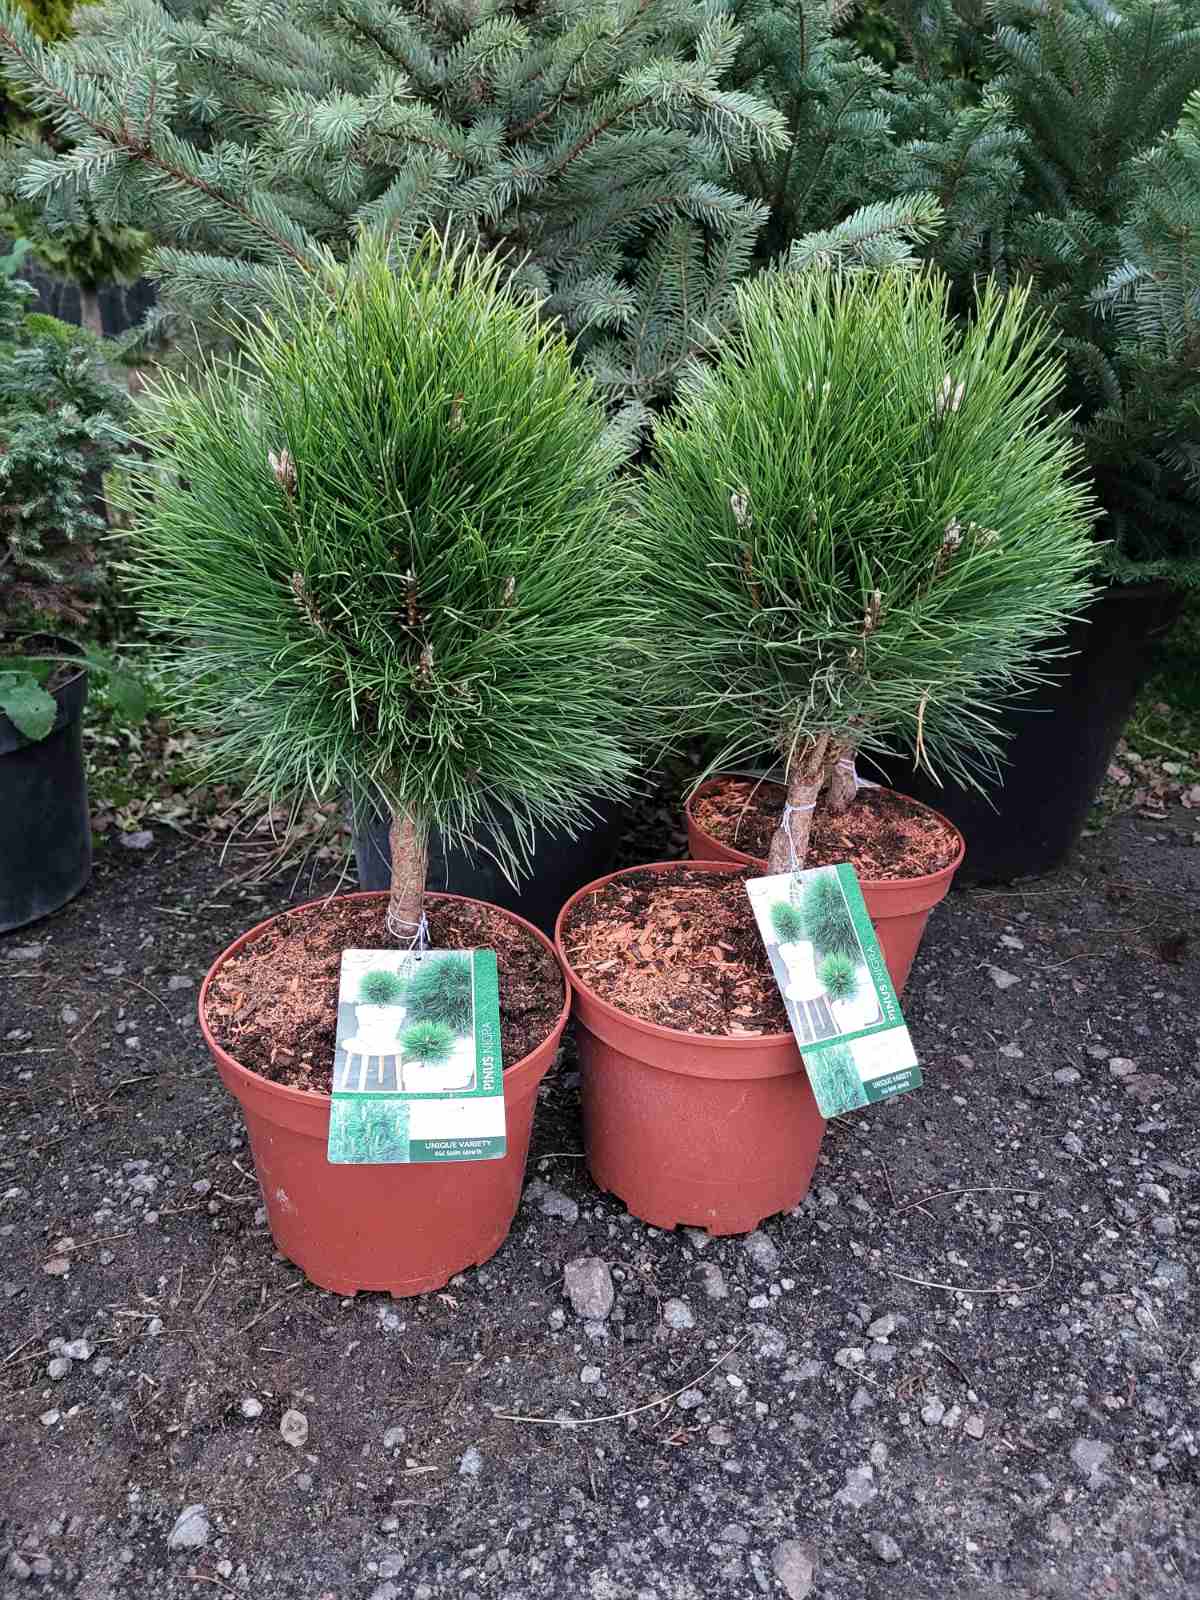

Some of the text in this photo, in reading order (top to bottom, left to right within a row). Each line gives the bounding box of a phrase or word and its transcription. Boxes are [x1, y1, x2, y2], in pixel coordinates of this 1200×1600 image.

[867, 945, 896, 1022] PINUS NIGRA
[481, 1022, 494, 1091] PINUS NIGRA
[425, 1140, 492, 1150] UNIQUE VARIETY
